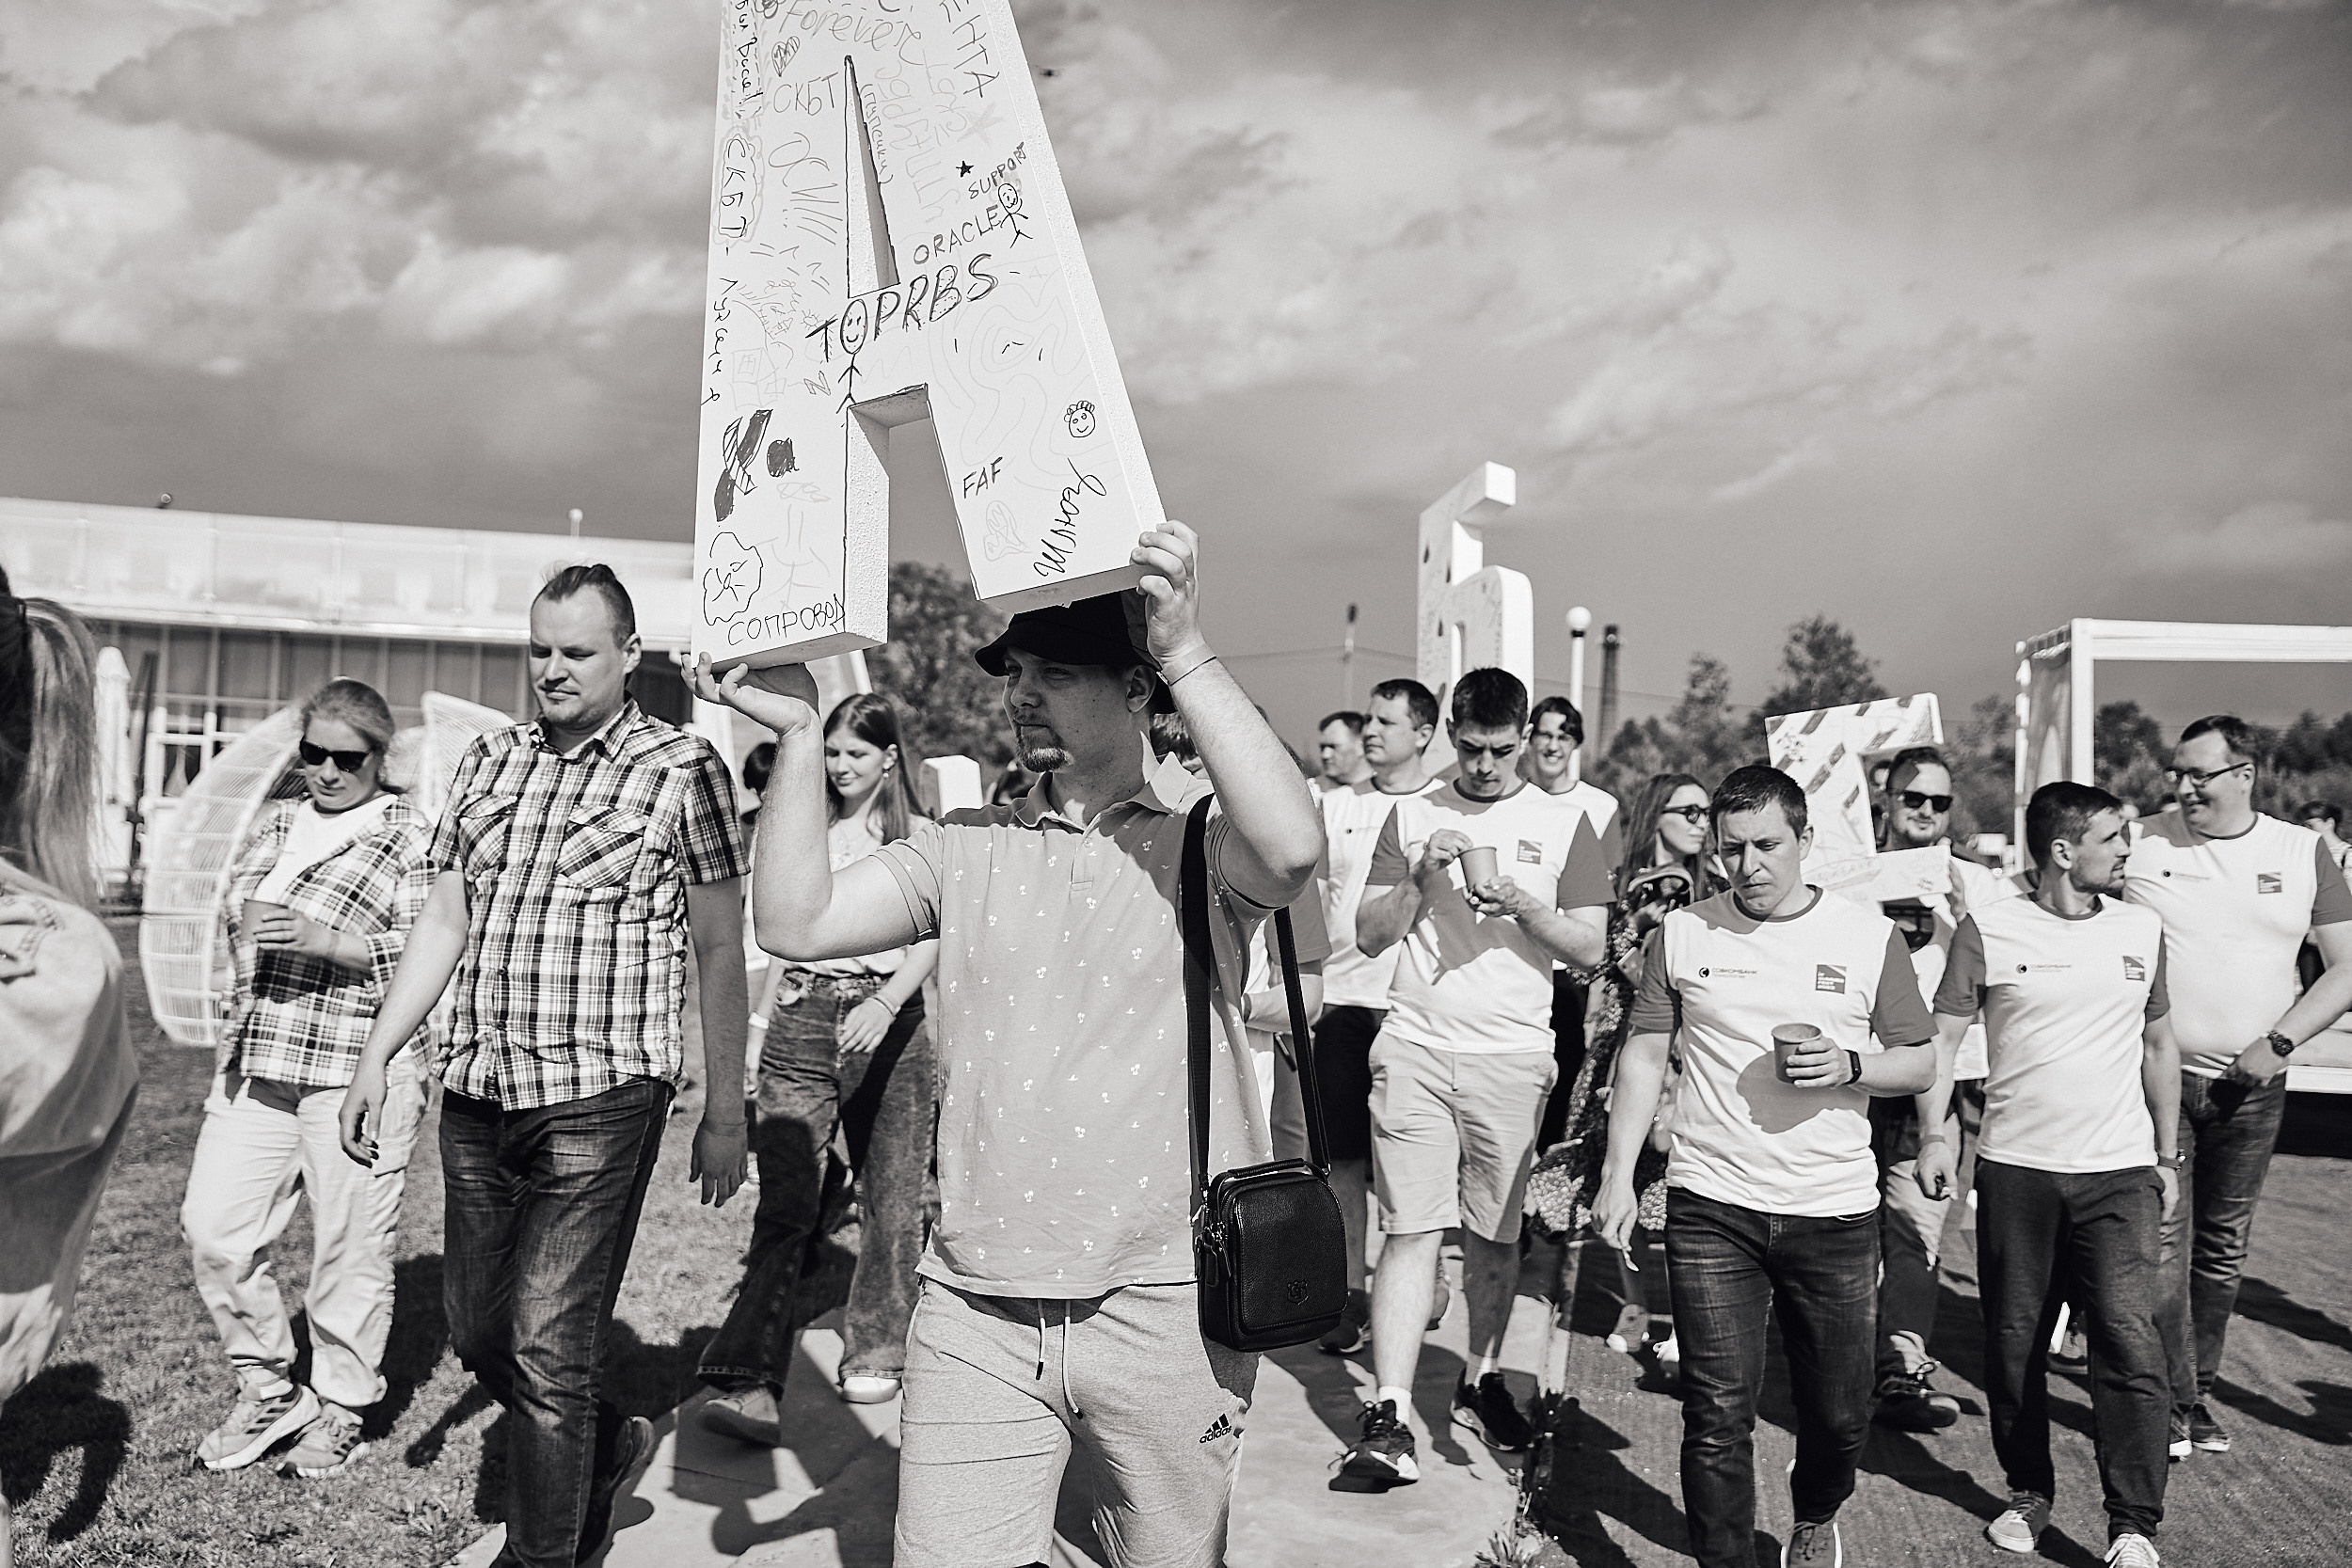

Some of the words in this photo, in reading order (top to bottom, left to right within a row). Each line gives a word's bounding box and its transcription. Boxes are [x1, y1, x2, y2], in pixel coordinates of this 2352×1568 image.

[773, 71, 839, 117] СКБТ
[721, 138, 747, 237] СКБТ
[968, 142, 1026, 199] SUPPORT
[914, 204, 1001, 264] ORACLE
[963, 456, 1003, 499] FAF
[728, 594, 846, 646] СОПРОВОД
[1199, 1425, 1232, 1444] adidas
